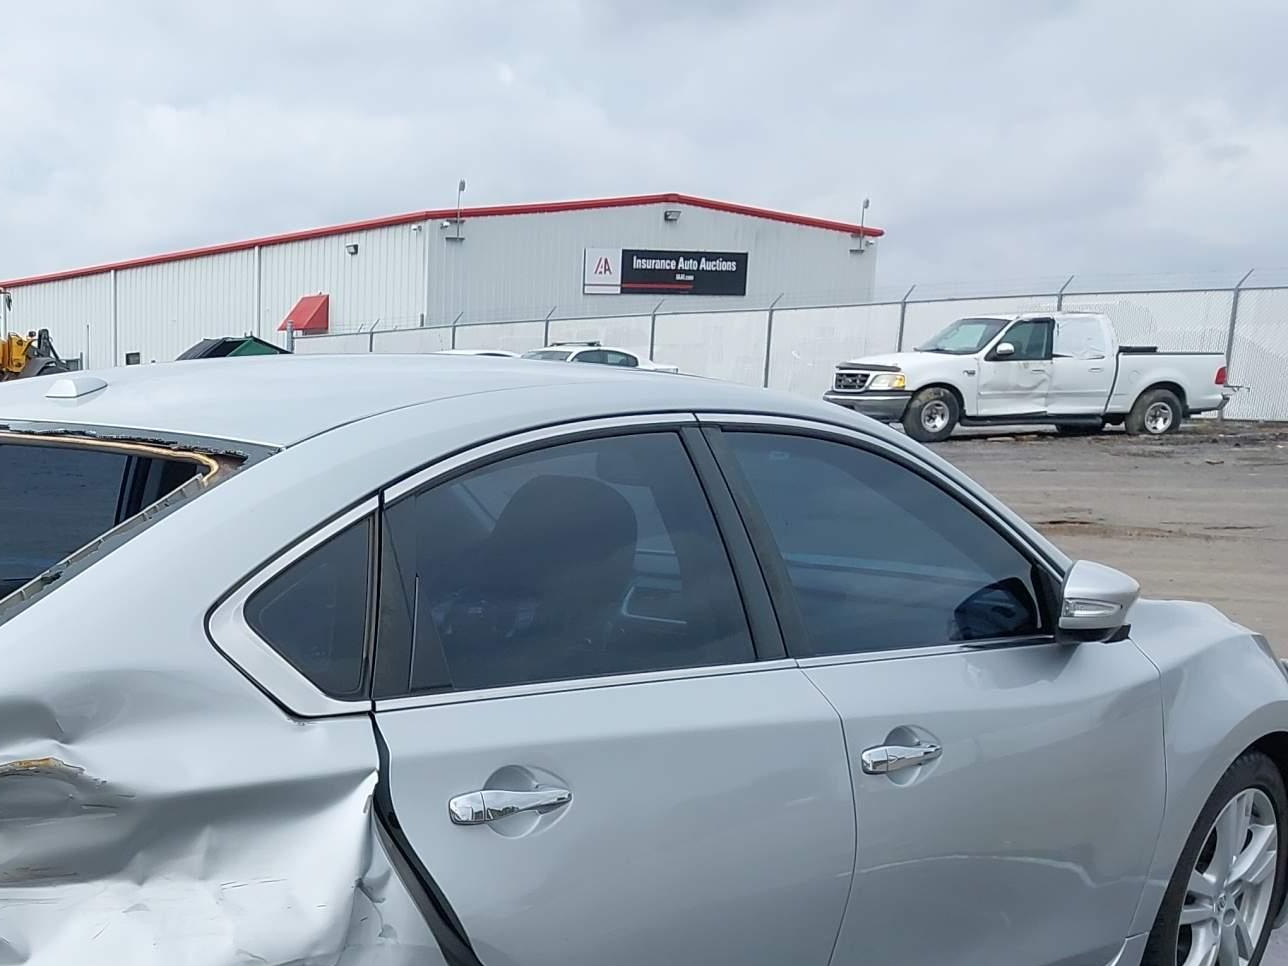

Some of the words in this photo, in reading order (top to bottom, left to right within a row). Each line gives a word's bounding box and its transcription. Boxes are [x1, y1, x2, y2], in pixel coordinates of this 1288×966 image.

[633, 255, 677, 270] Insurance
[677, 256, 698, 271] Auto
[699, 257, 737, 272] Auctions
